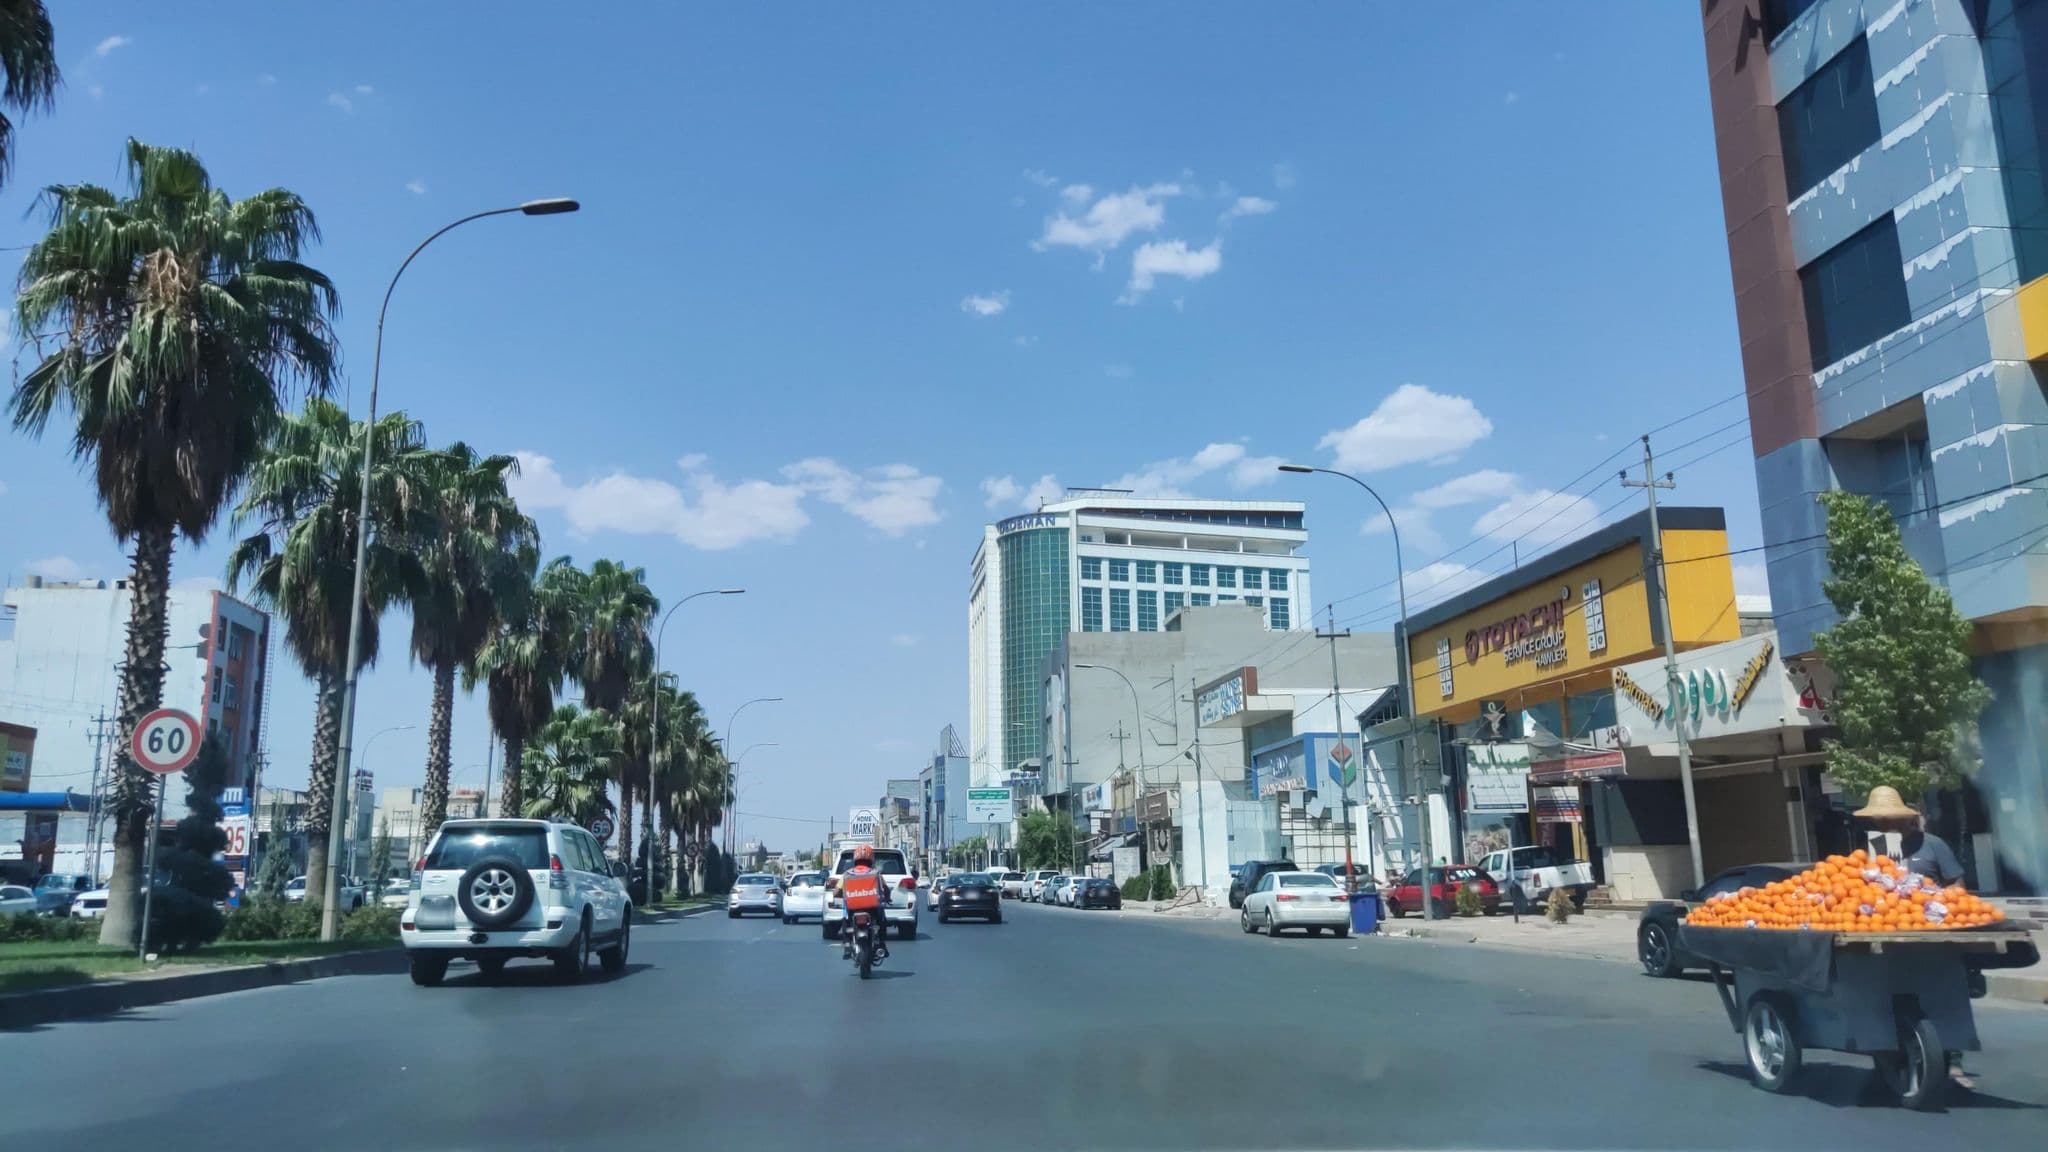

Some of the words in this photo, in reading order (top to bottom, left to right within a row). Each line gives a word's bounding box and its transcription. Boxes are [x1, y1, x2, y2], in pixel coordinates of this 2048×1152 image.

[1503, 640, 1535, 661] SERVICE
[1535, 631, 1565, 651] GROUP
[1535, 649, 1567, 666] HAWLER
[1613, 668, 1663, 721] Pharmacy
[150, 727, 184, 754] 60
[846, 888, 877, 898] talabat
